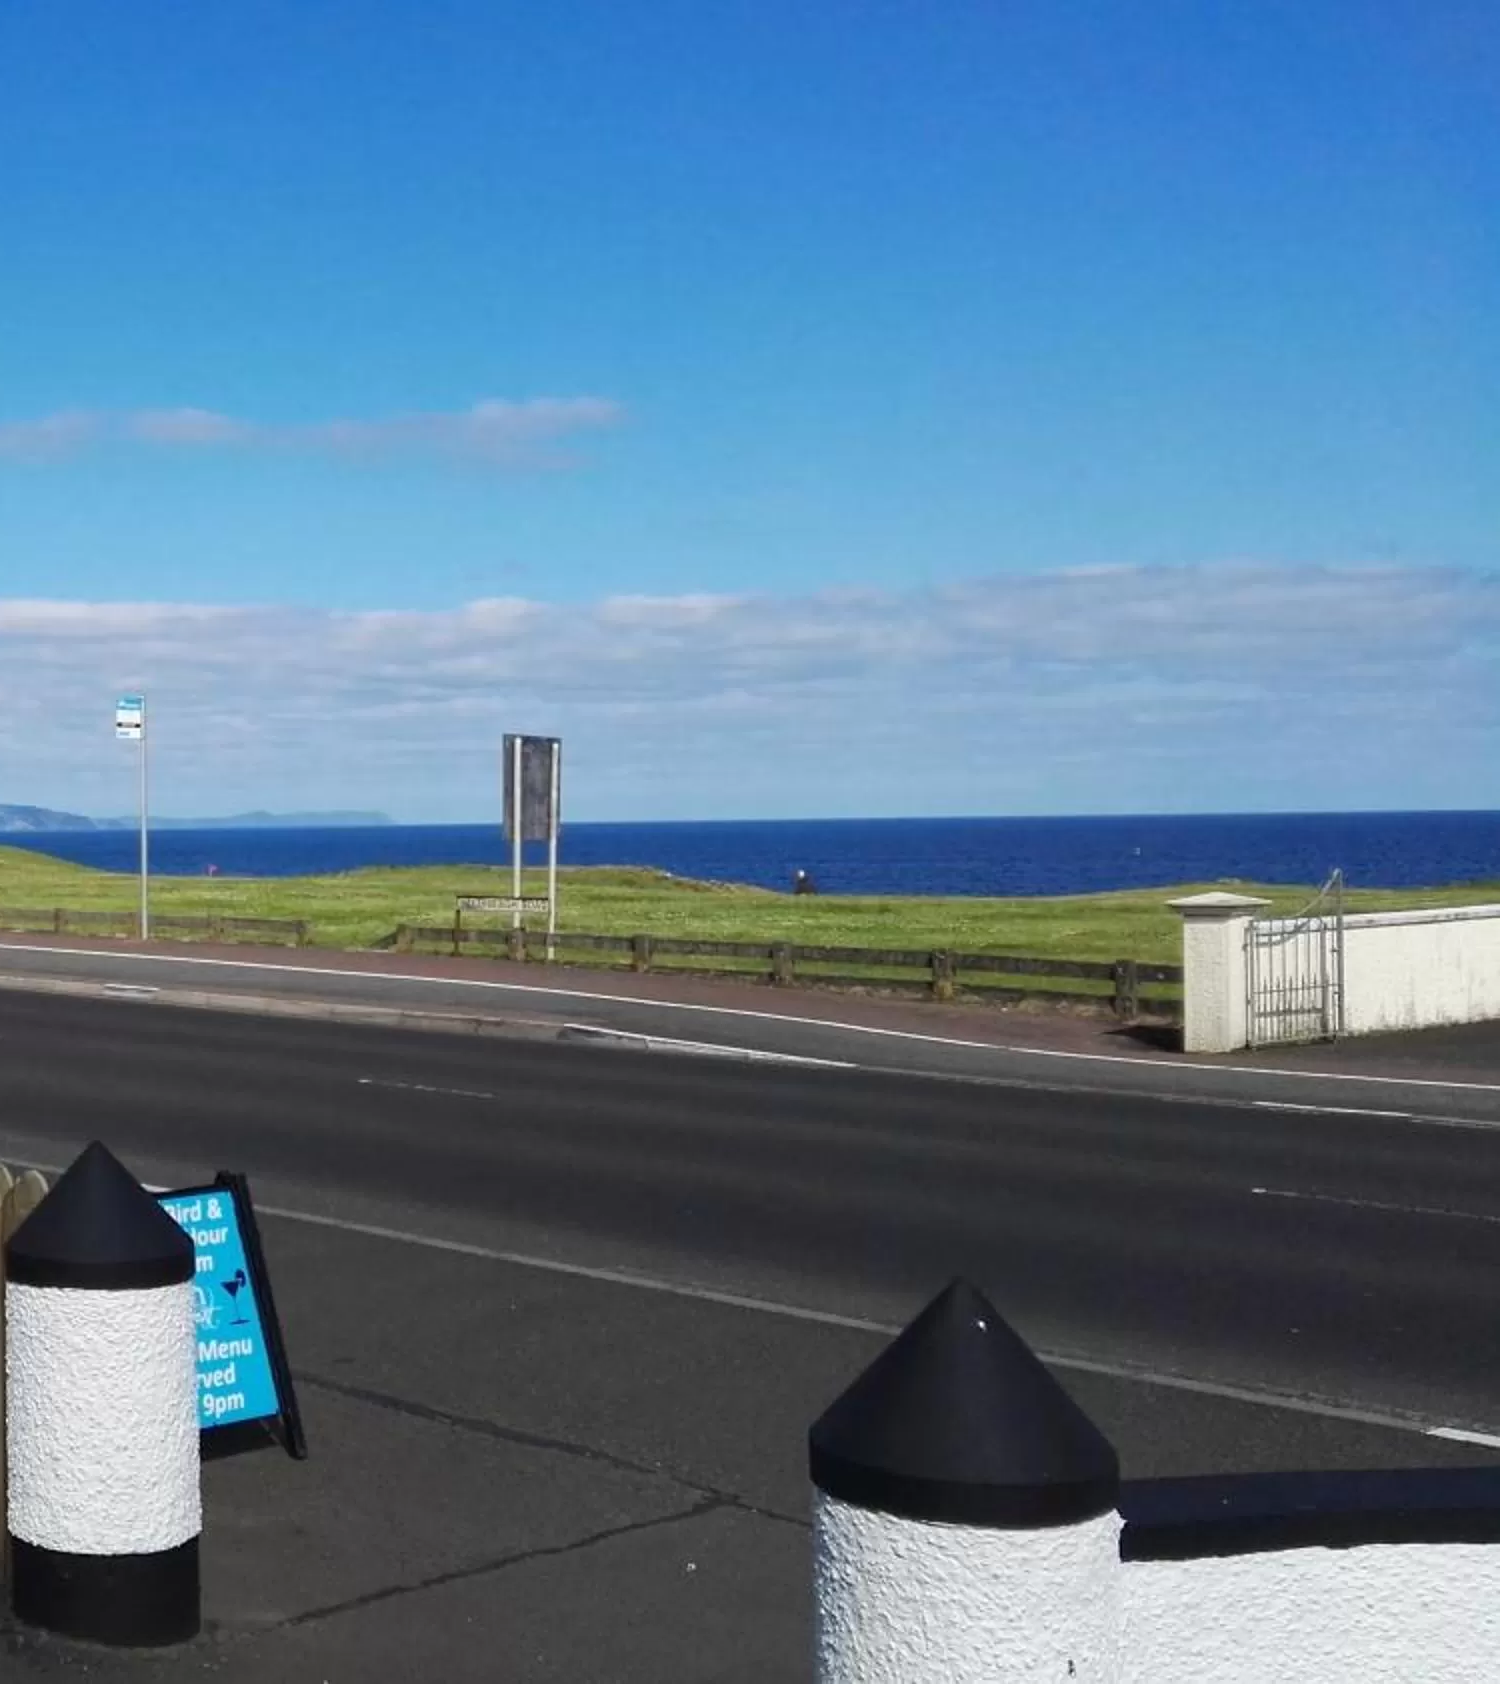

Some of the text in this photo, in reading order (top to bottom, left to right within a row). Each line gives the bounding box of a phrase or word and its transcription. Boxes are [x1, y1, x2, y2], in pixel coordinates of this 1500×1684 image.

[208, 1198, 222, 1219] &
[199, 1338, 252, 1362] Menu
[203, 1392, 244, 1418] 9pm
